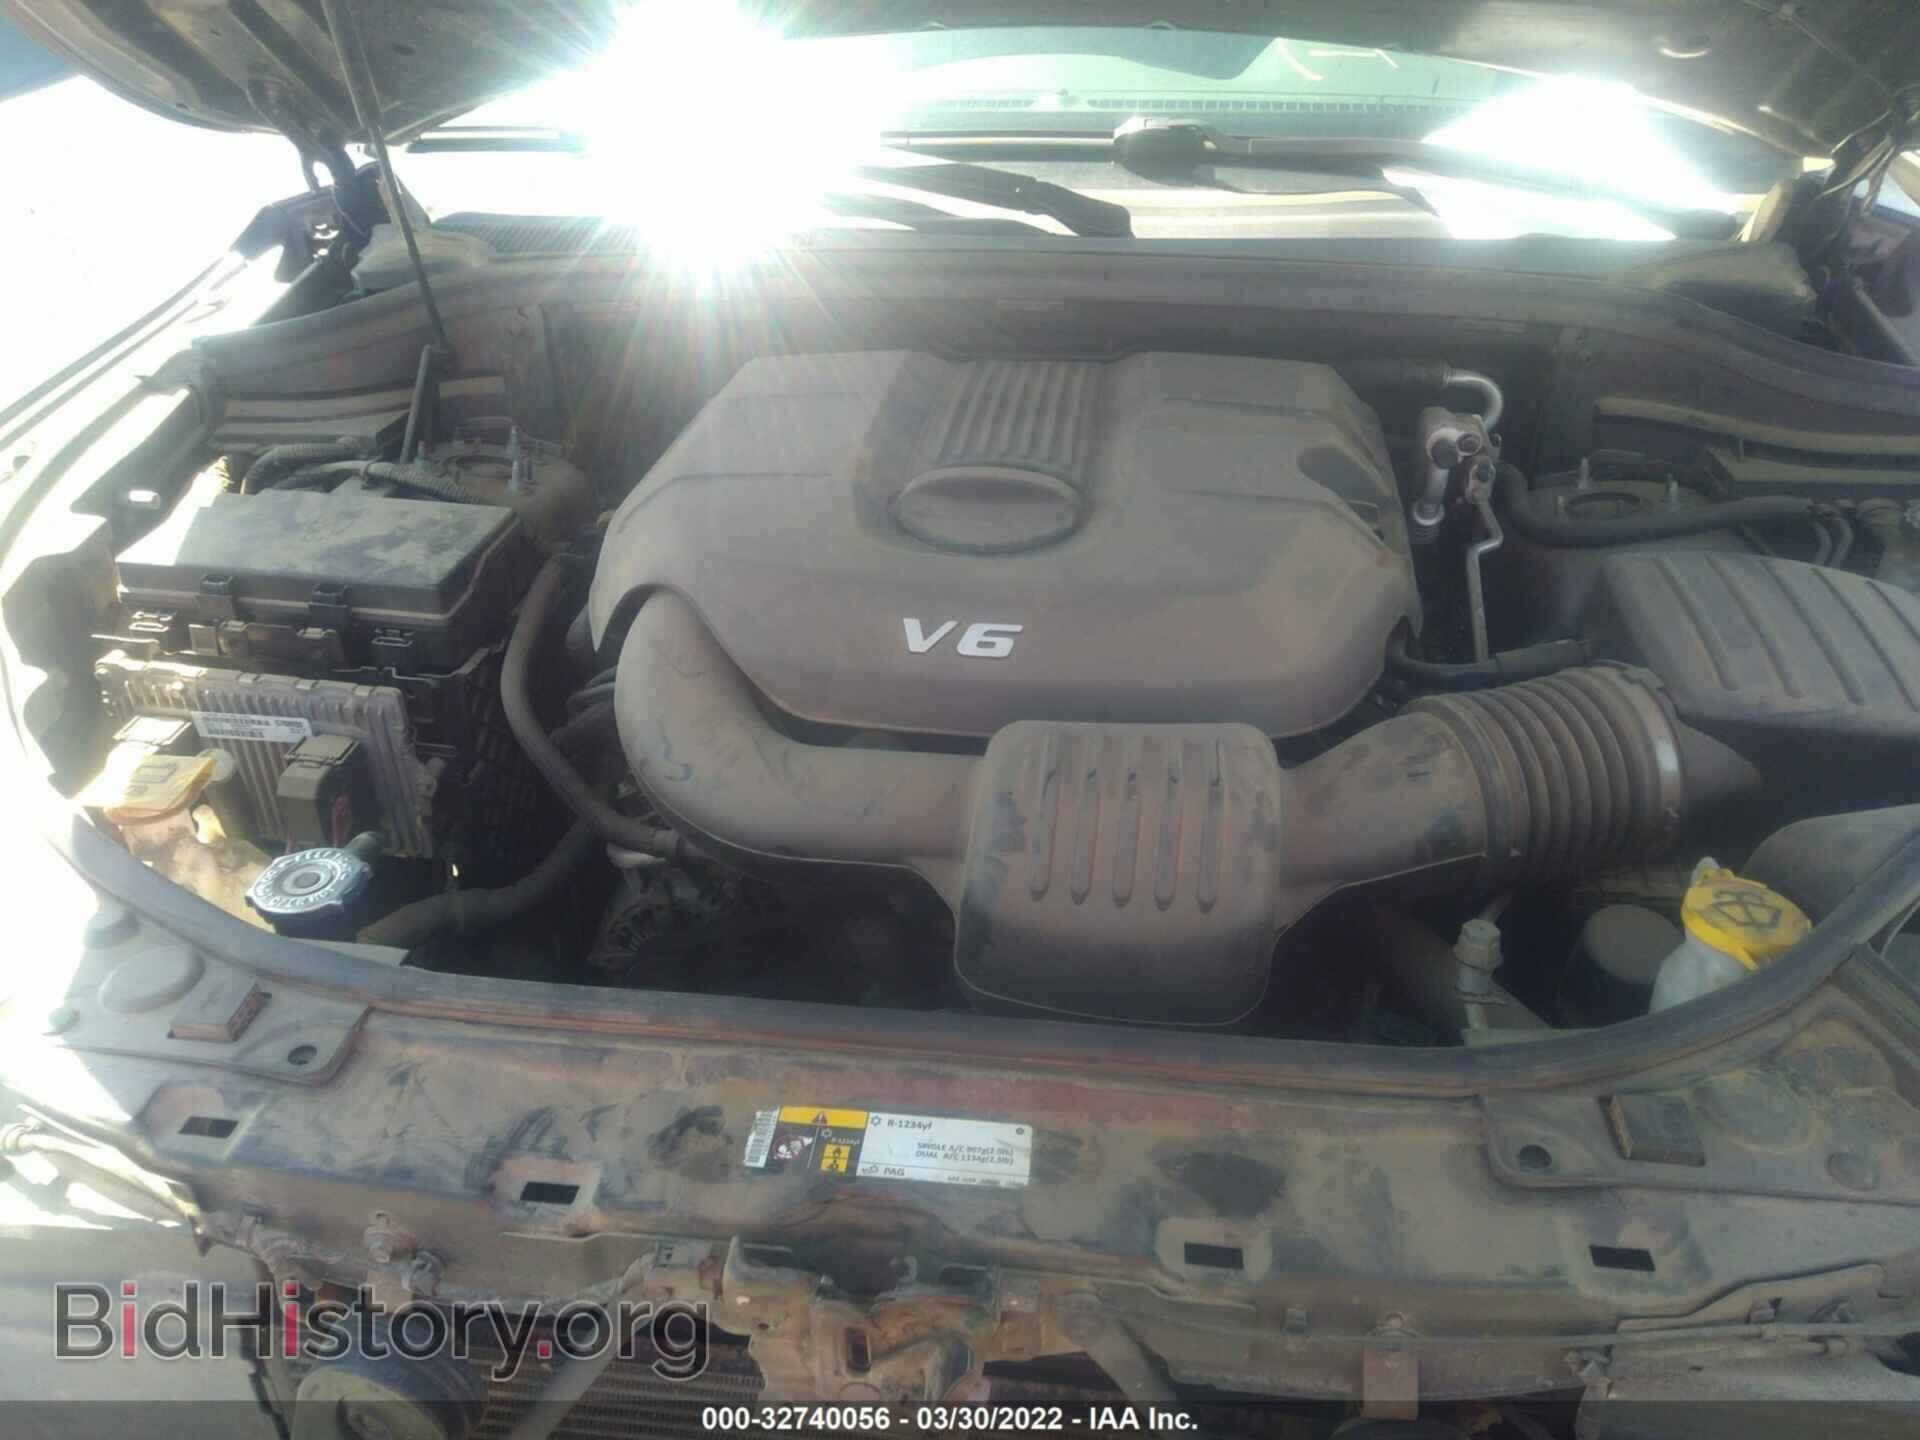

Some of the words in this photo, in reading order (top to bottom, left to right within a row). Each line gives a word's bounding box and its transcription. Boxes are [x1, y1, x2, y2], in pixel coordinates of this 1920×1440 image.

[903, 617, 1023, 658] V6
[886, 1116, 933, 1133] R-1234yf
[883, 1167, 905, 1177] PAG
